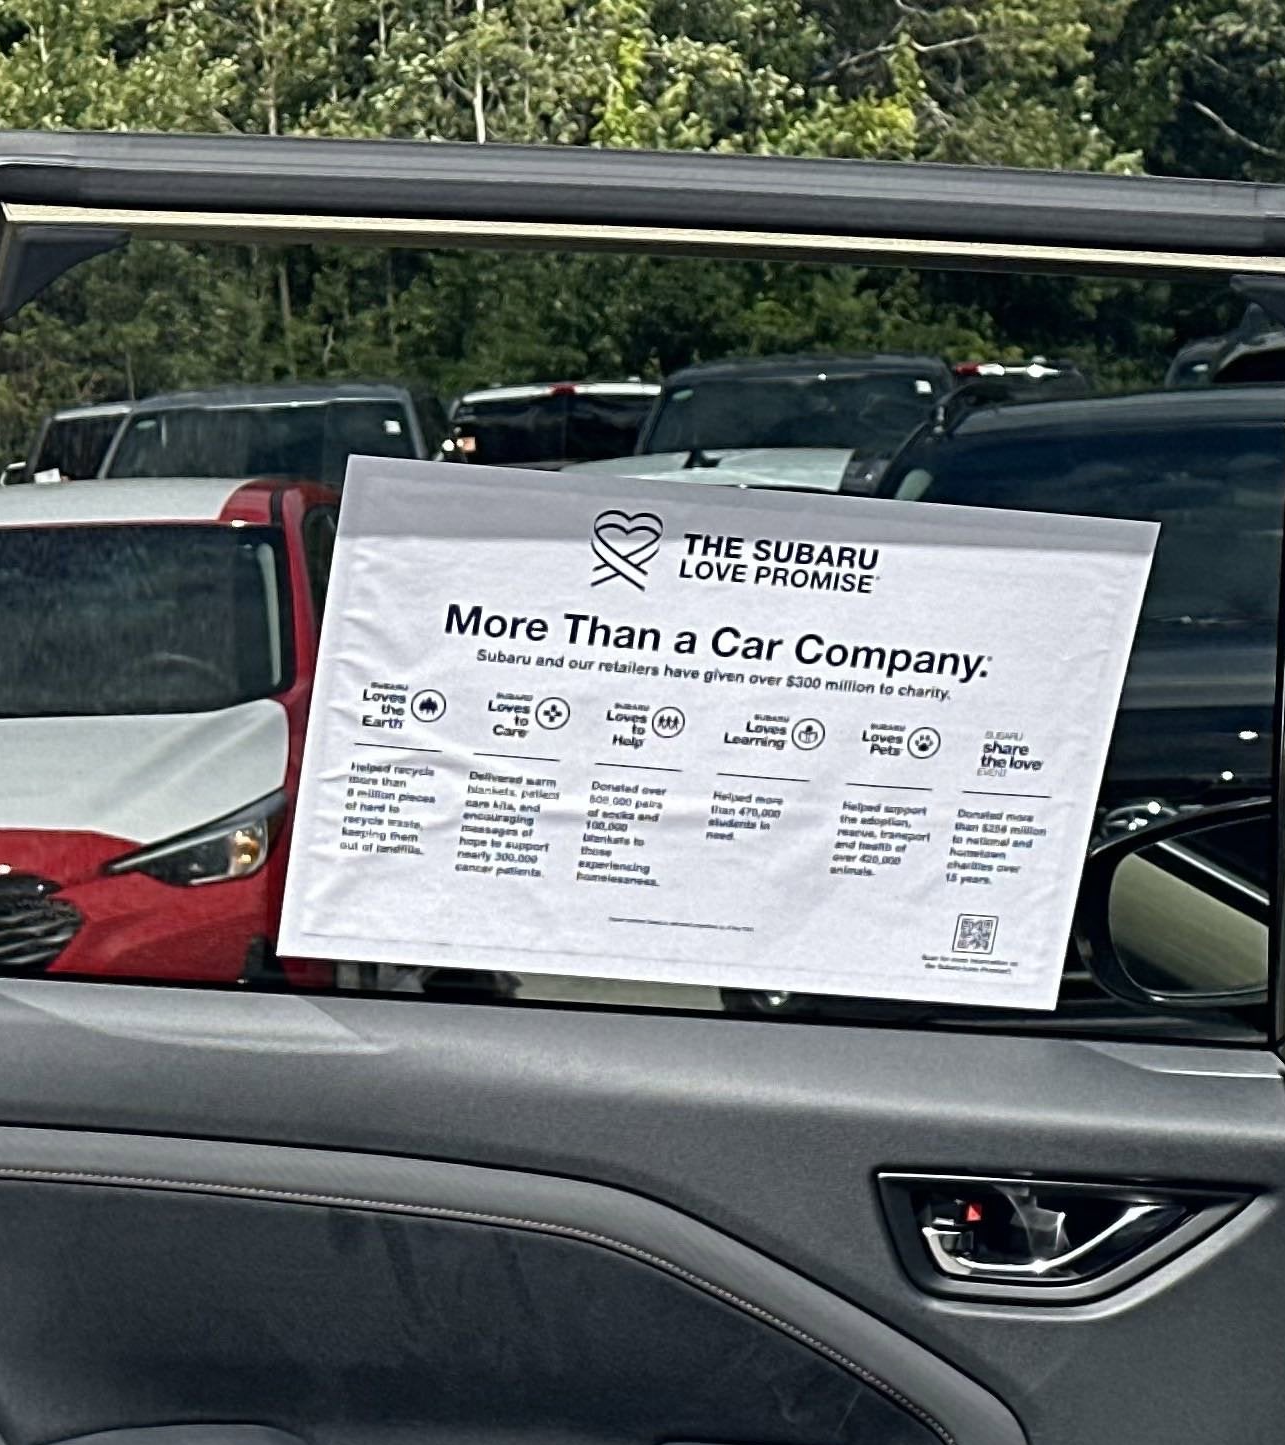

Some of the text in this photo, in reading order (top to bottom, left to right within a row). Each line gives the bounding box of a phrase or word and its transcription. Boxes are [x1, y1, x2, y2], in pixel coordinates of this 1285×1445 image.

[683, 532, 880, 571] THE SUBARU
[678, 557, 875, 594] LOVE PROMISE
[444, 603, 549, 642] More
[563, 612, 661, 652] Than
[673, 630, 697, 655] a
[710, 625, 784, 662] Car
[475, 648, 951, 702] Subaru and our retailers have given over $300 million to charity.
[362, 688, 407, 704] Loves
[380, 703, 406, 716] the
[487, 699, 532, 714] Loves
[361, 715, 406, 729] Earth
[513, 713, 530, 726] to
[606, 709, 649, 724] Loves
[492, 724, 530, 738] Care
[631, 723, 647, 735] to
[745, 720, 788, 735] Loves
[612, 734, 647, 749] Help
[723, 732, 788, 750] Learning
[861, 729, 904, 744] Loves
[869, 742, 905, 756] Pets
[982, 740, 1030, 756] share
[980, 753, 1045, 771] the love
